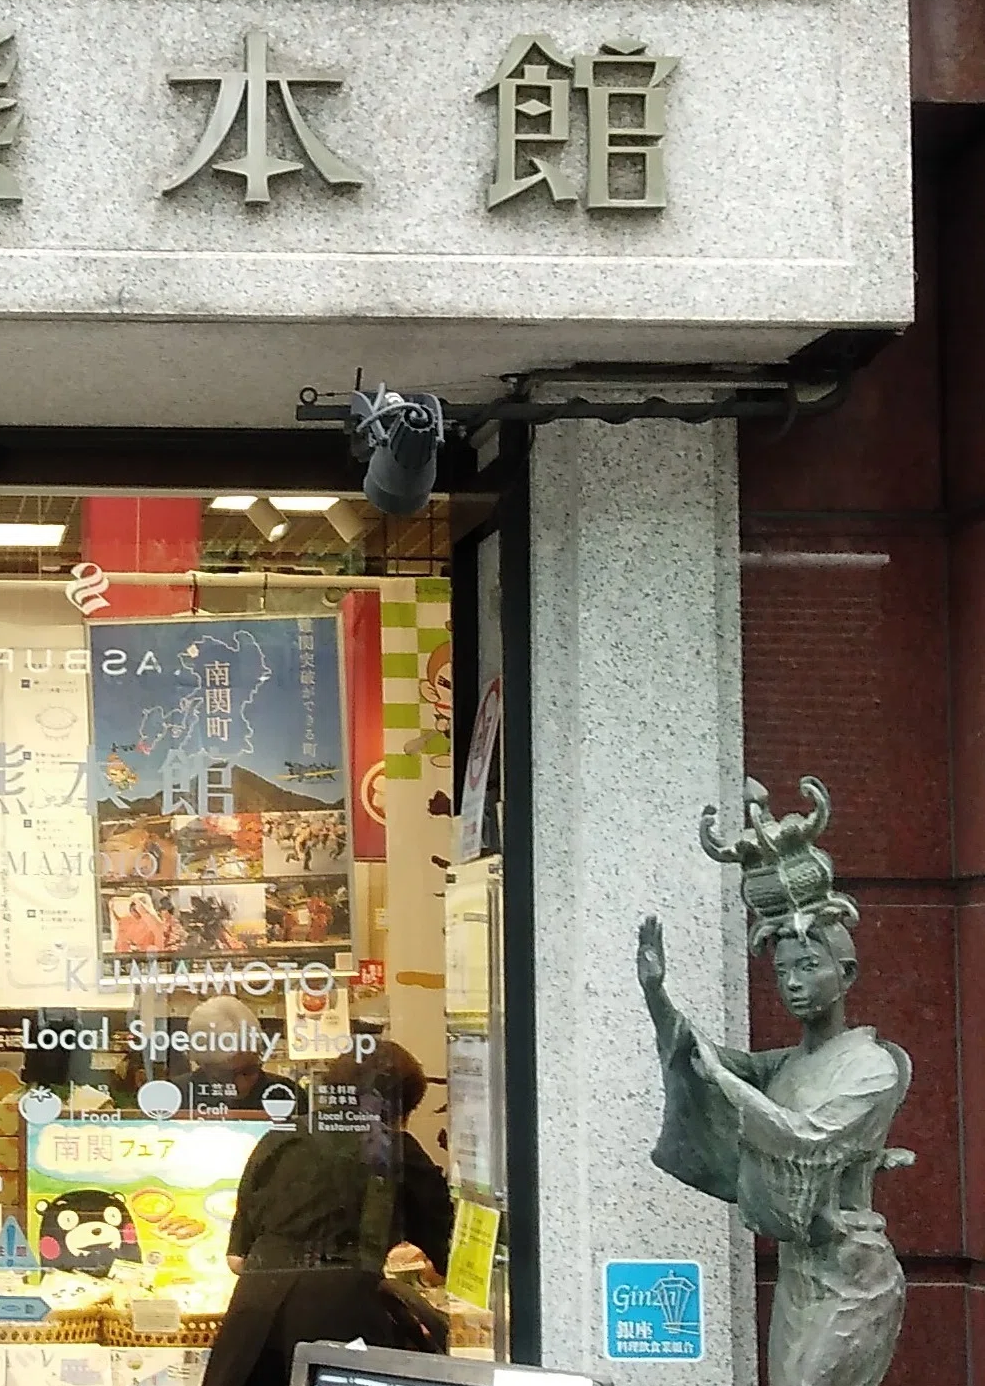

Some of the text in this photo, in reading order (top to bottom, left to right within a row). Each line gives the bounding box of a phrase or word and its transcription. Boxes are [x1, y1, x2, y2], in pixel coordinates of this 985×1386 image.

[205, 660, 232, 742] 南関町
[65, 961, 335, 996] KUMAMOTO
[22, 1018, 377, 1063] Local Specialty Shop
[197, 1083, 238, 1097] 工芸品
[81, 1110, 122, 1123] Food
[197, 1102, 229, 1116] Craft
